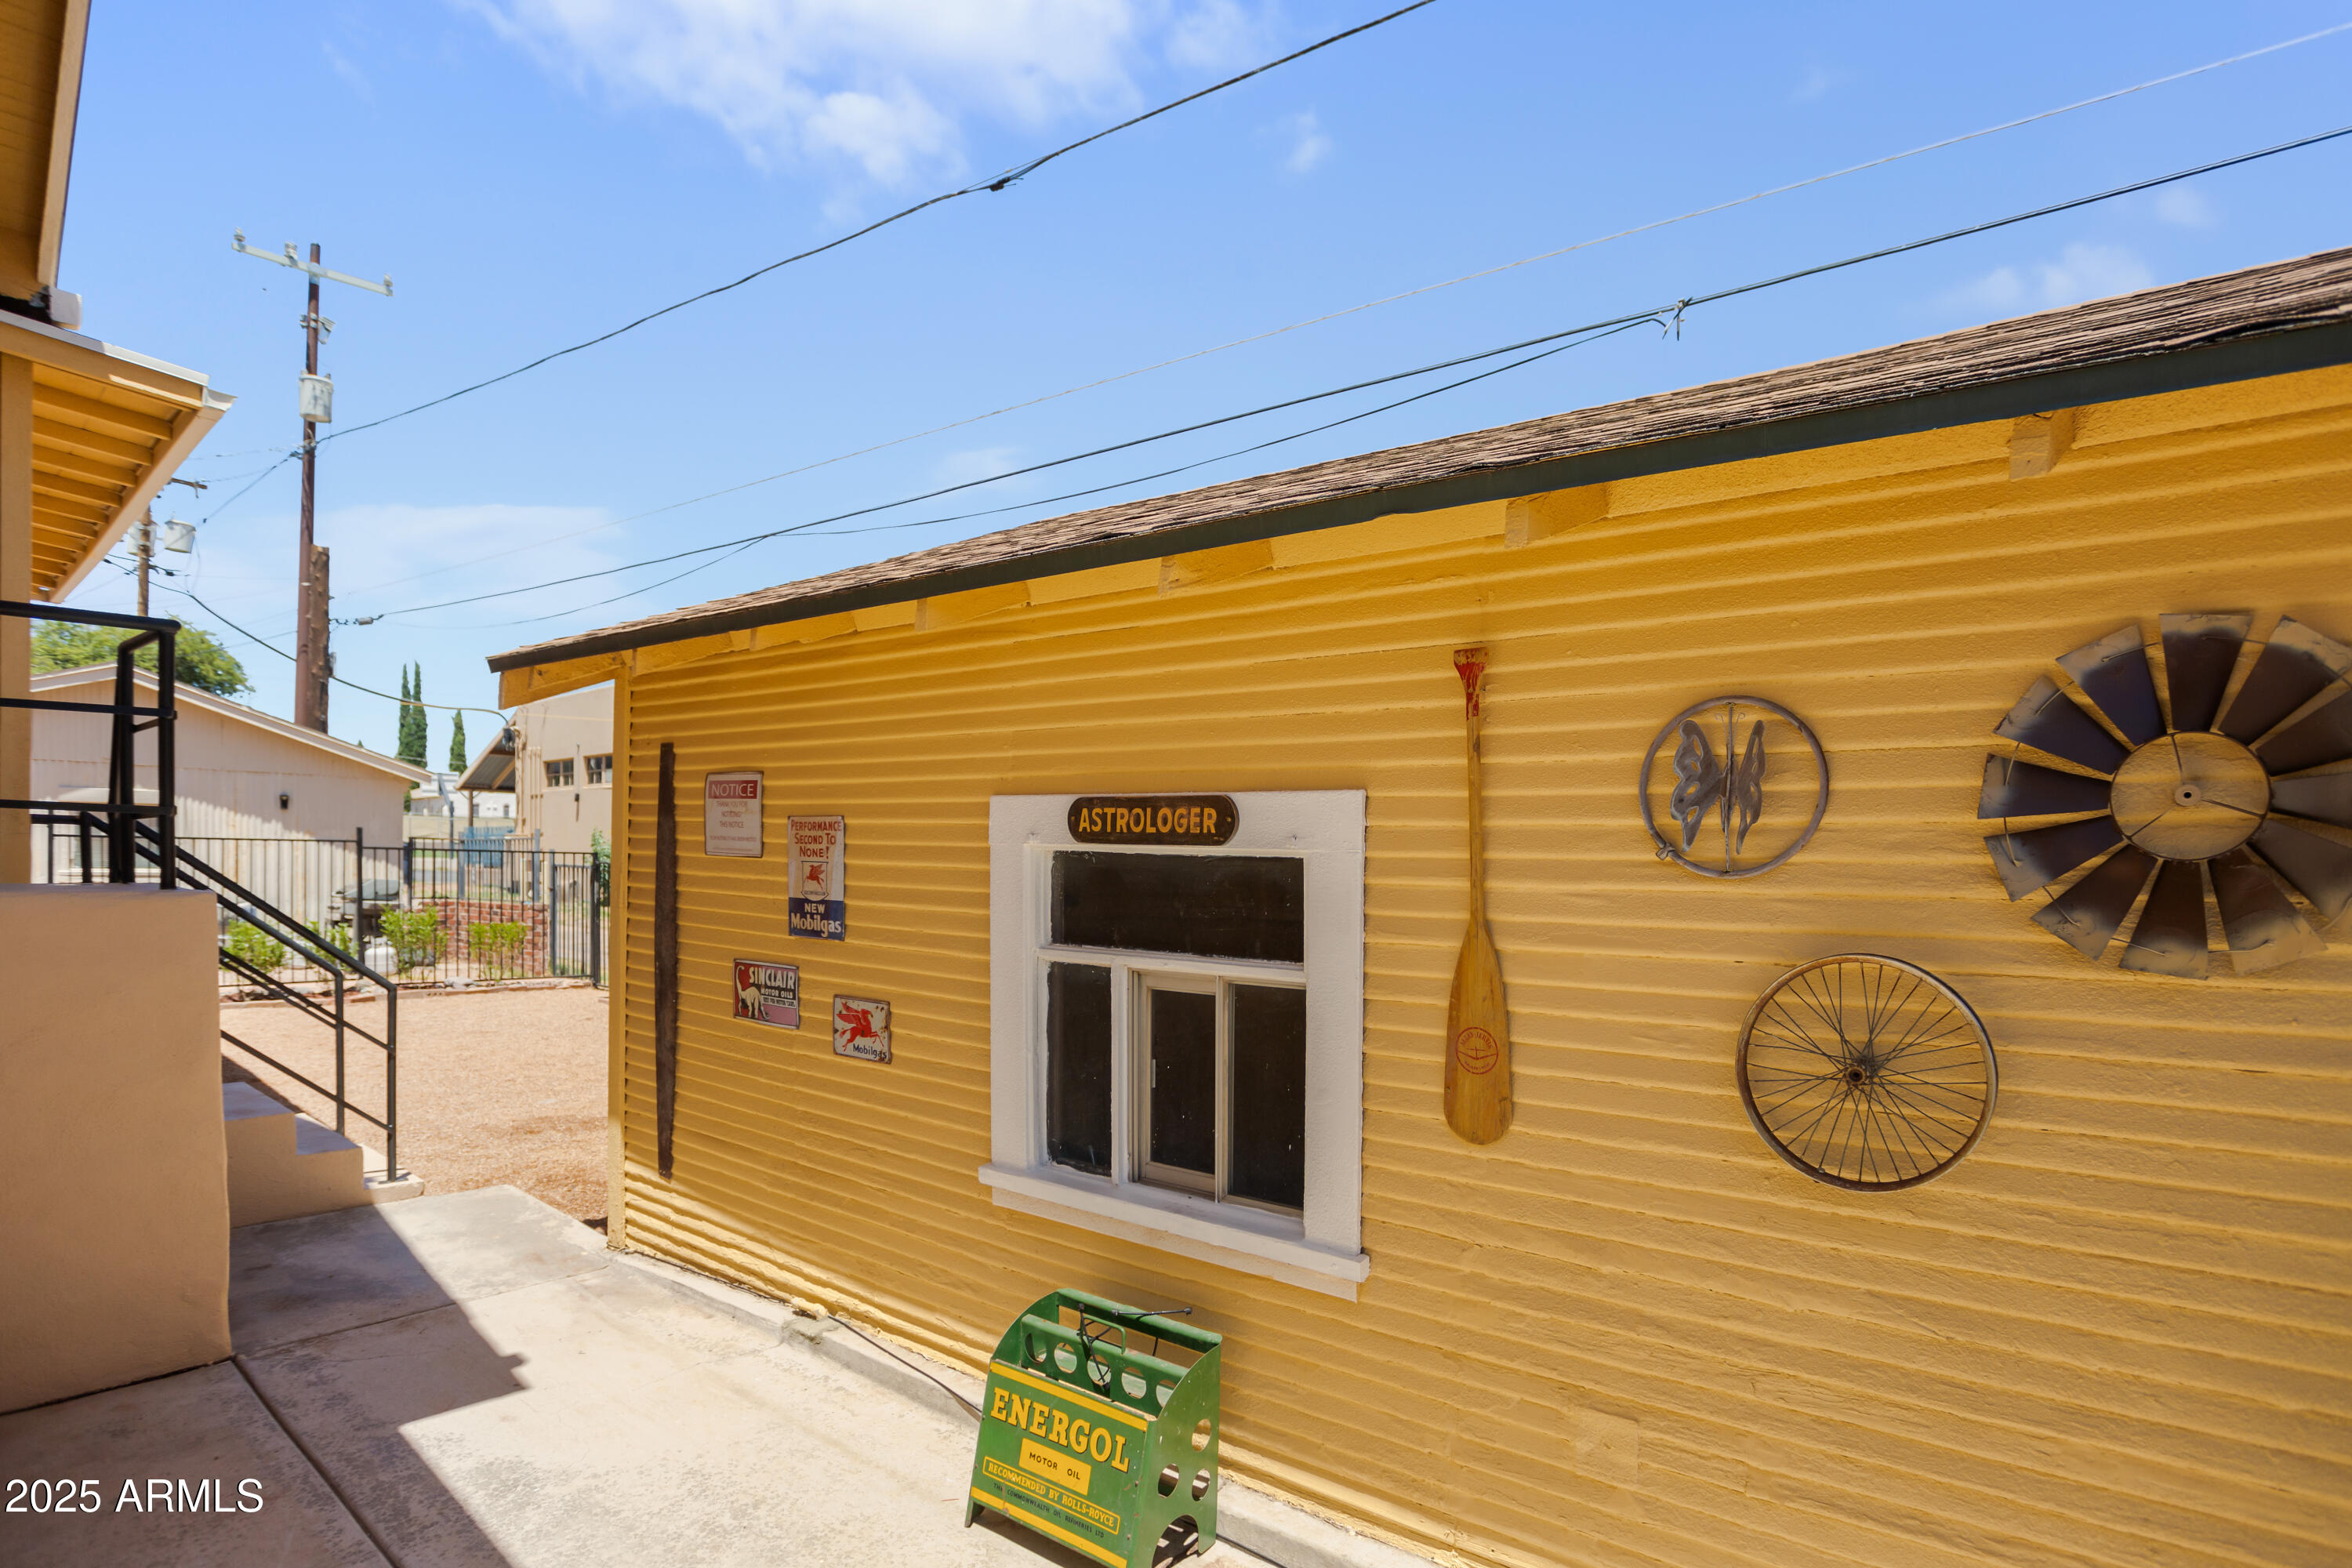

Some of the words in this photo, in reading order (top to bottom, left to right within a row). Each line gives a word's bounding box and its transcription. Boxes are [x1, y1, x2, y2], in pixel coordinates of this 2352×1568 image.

[711, 783, 755, 797] NOTICE
[790, 818, 842, 832] PERFORMANCE
[1078, 807, 1218, 834] ASTROLOGER
[794, 832, 823, 845] SECOND
[799, 845, 829, 859] NONE!
[804, 902, 826, 914] NEW
[790, 913, 842, 938] Mobilgas
[749, 966, 795, 989] SINCLAIR
[761, 988, 779, 997] MOTOR
[780, 990, 793, 999] OILS
[852, 1043, 887, 1059] Mobilgas
[990, 1386, 1130, 1474] ENERGOL
[1029, 1451, 1058, 1471] MOTOR
[1066, 1468, 1081, 1480] OIL
[988, 1461, 1046, 1495] RECOMMENDED
[1047, 1489, 1060, 1501] BY
[1061, 1495, 1114, 1527] ROLLS-ROYCE
[1007, 1489, 1050, 1514] COMMONWEALTH
[1053, 1509, 1062, 1519] OIL
[1065, 1515, 1092, 1534] REFINERIES
[1094, 1529, 1105, 1539] LTD
